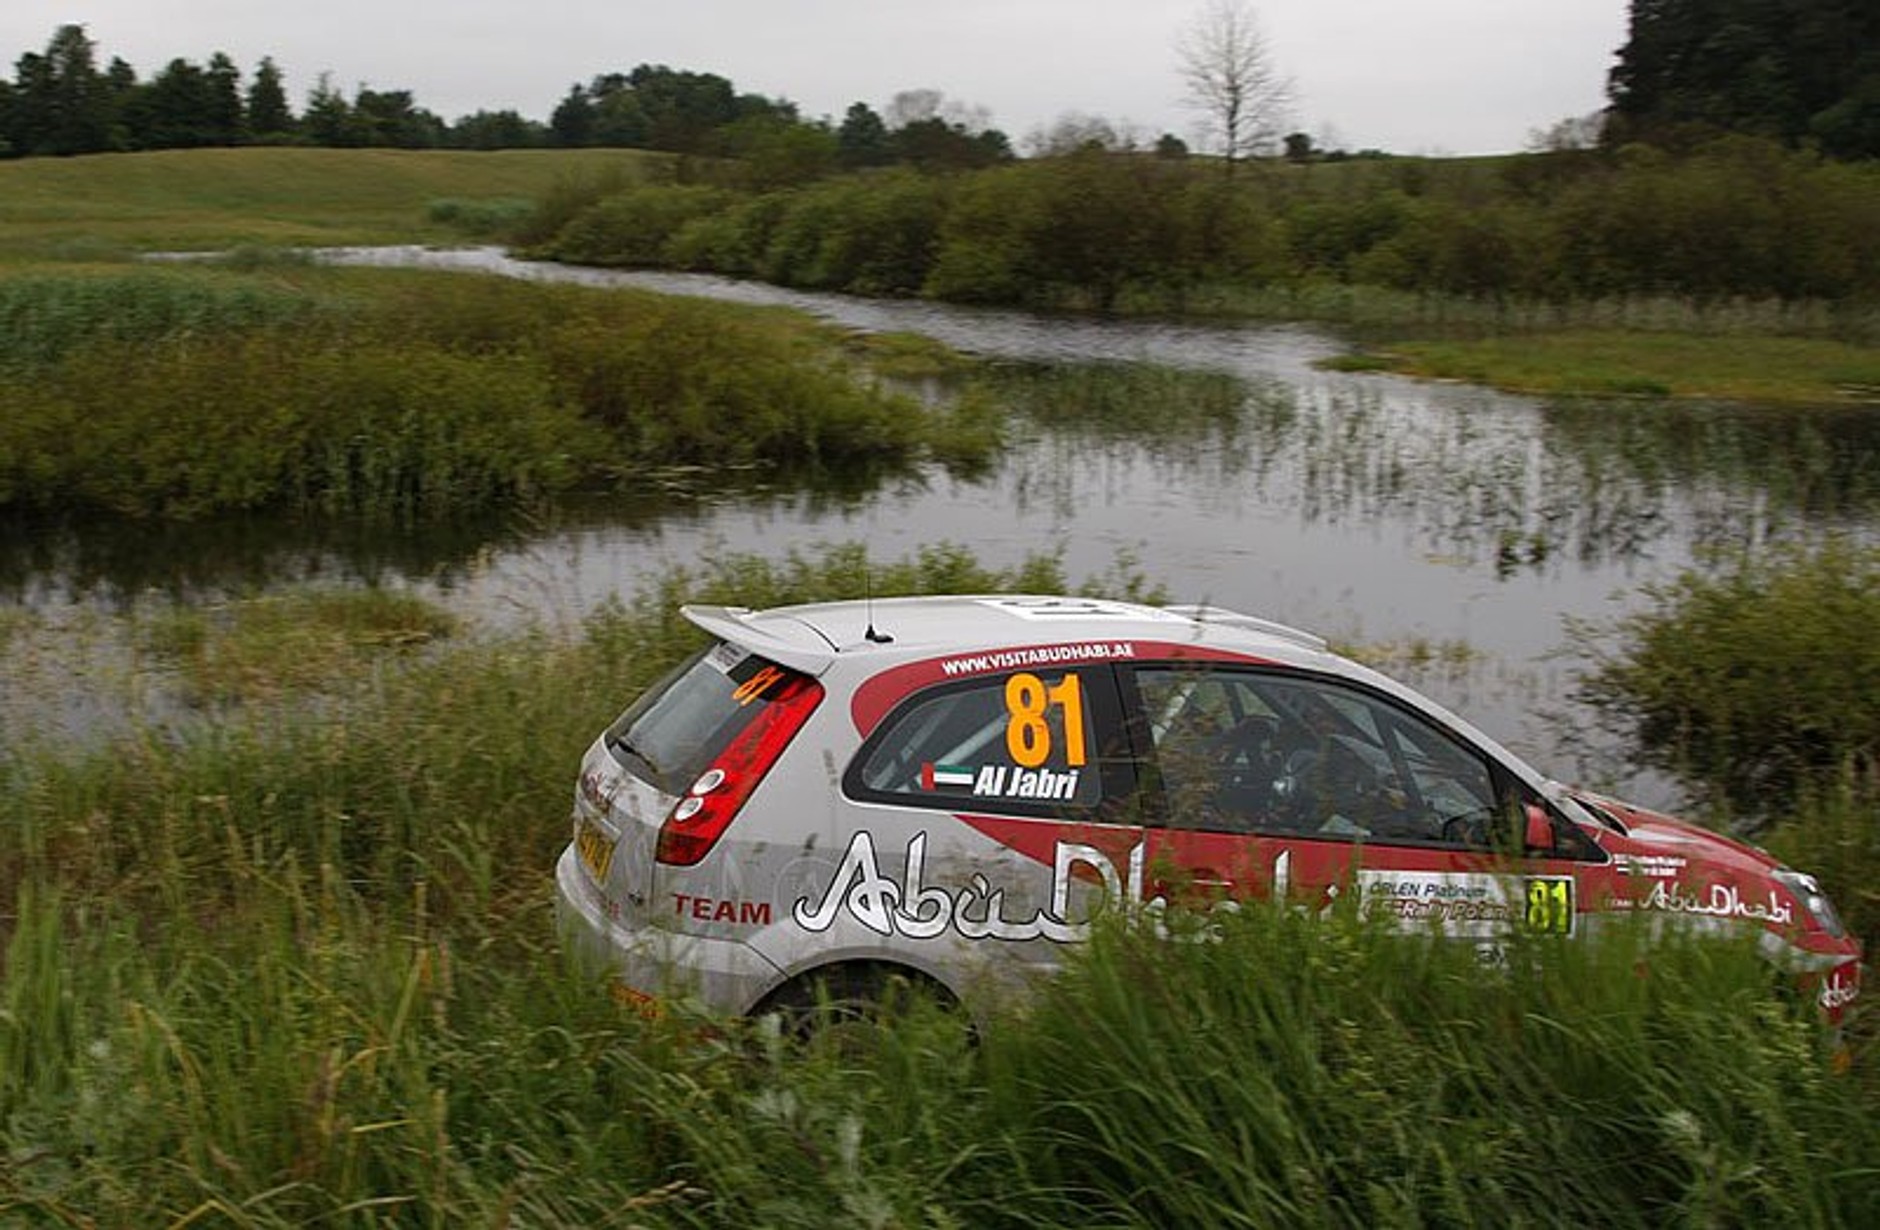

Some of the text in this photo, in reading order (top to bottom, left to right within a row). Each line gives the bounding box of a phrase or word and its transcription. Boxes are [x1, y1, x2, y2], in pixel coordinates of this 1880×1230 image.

[941, 642, 1135, 676] WWW.VISITABUDHABI.AE
[732, 665, 785, 707] 81
[1004, 672, 1087, 767] 81
[972, 766, 1080, 799] Al Jabri
[673, 894, 772, 925] TEAM
[1529, 880, 1567, 933] 81
